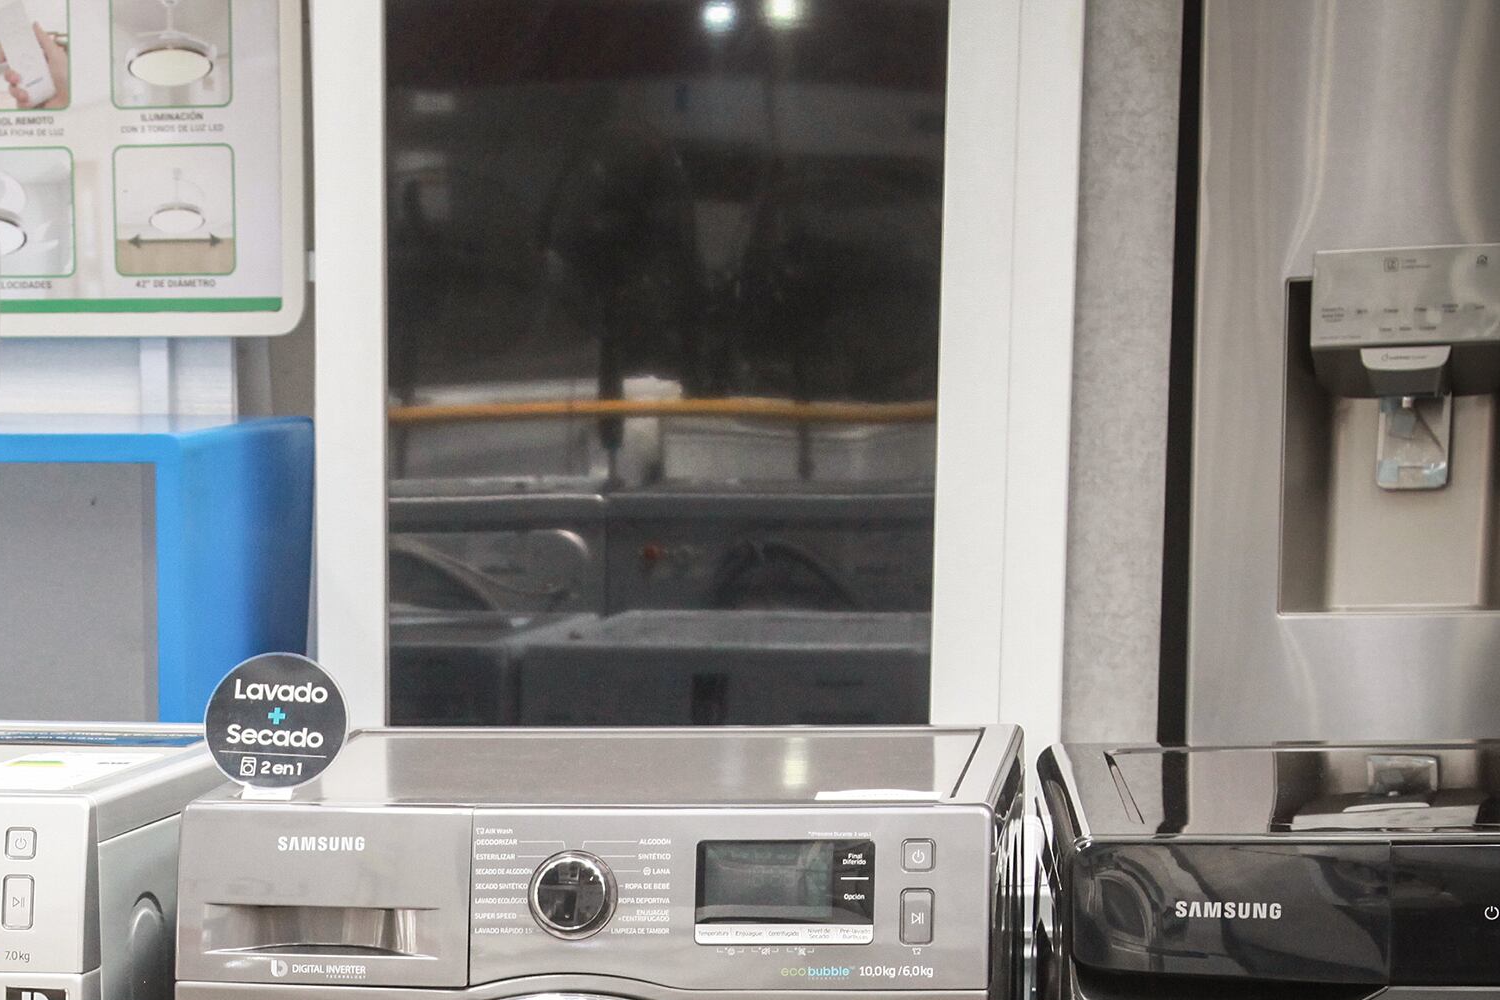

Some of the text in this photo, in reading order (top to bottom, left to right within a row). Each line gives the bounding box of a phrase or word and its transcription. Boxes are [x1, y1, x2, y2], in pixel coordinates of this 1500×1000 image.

[15, 115, 54, 126] REMOTO
[140, 111, 204, 122] ILUMINACIÓN
[153, 279, 166, 288] DE
[168, 277, 217, 288] DIÁMETRO
[234, 678, 328, 704] Lavado
[226, 723, 324, 748] Secado
[260, 760, 303, 776] 2 en 1
[277, 835, 365, 852] SAMSUNG
[506, 867, 533, 875] ALGODÓN
[499, 882, 528, 890] SINTÉTICO
[653, 882, 670, 890] BEBÉ
[1175, 900, 1282, 920] SAMSUNG
[4, 950, 31, 963] 7.0kg
[292, 964, 366, 974] DIGITAL INVERTER
[859, 966, 896, 978] 10,0kg
